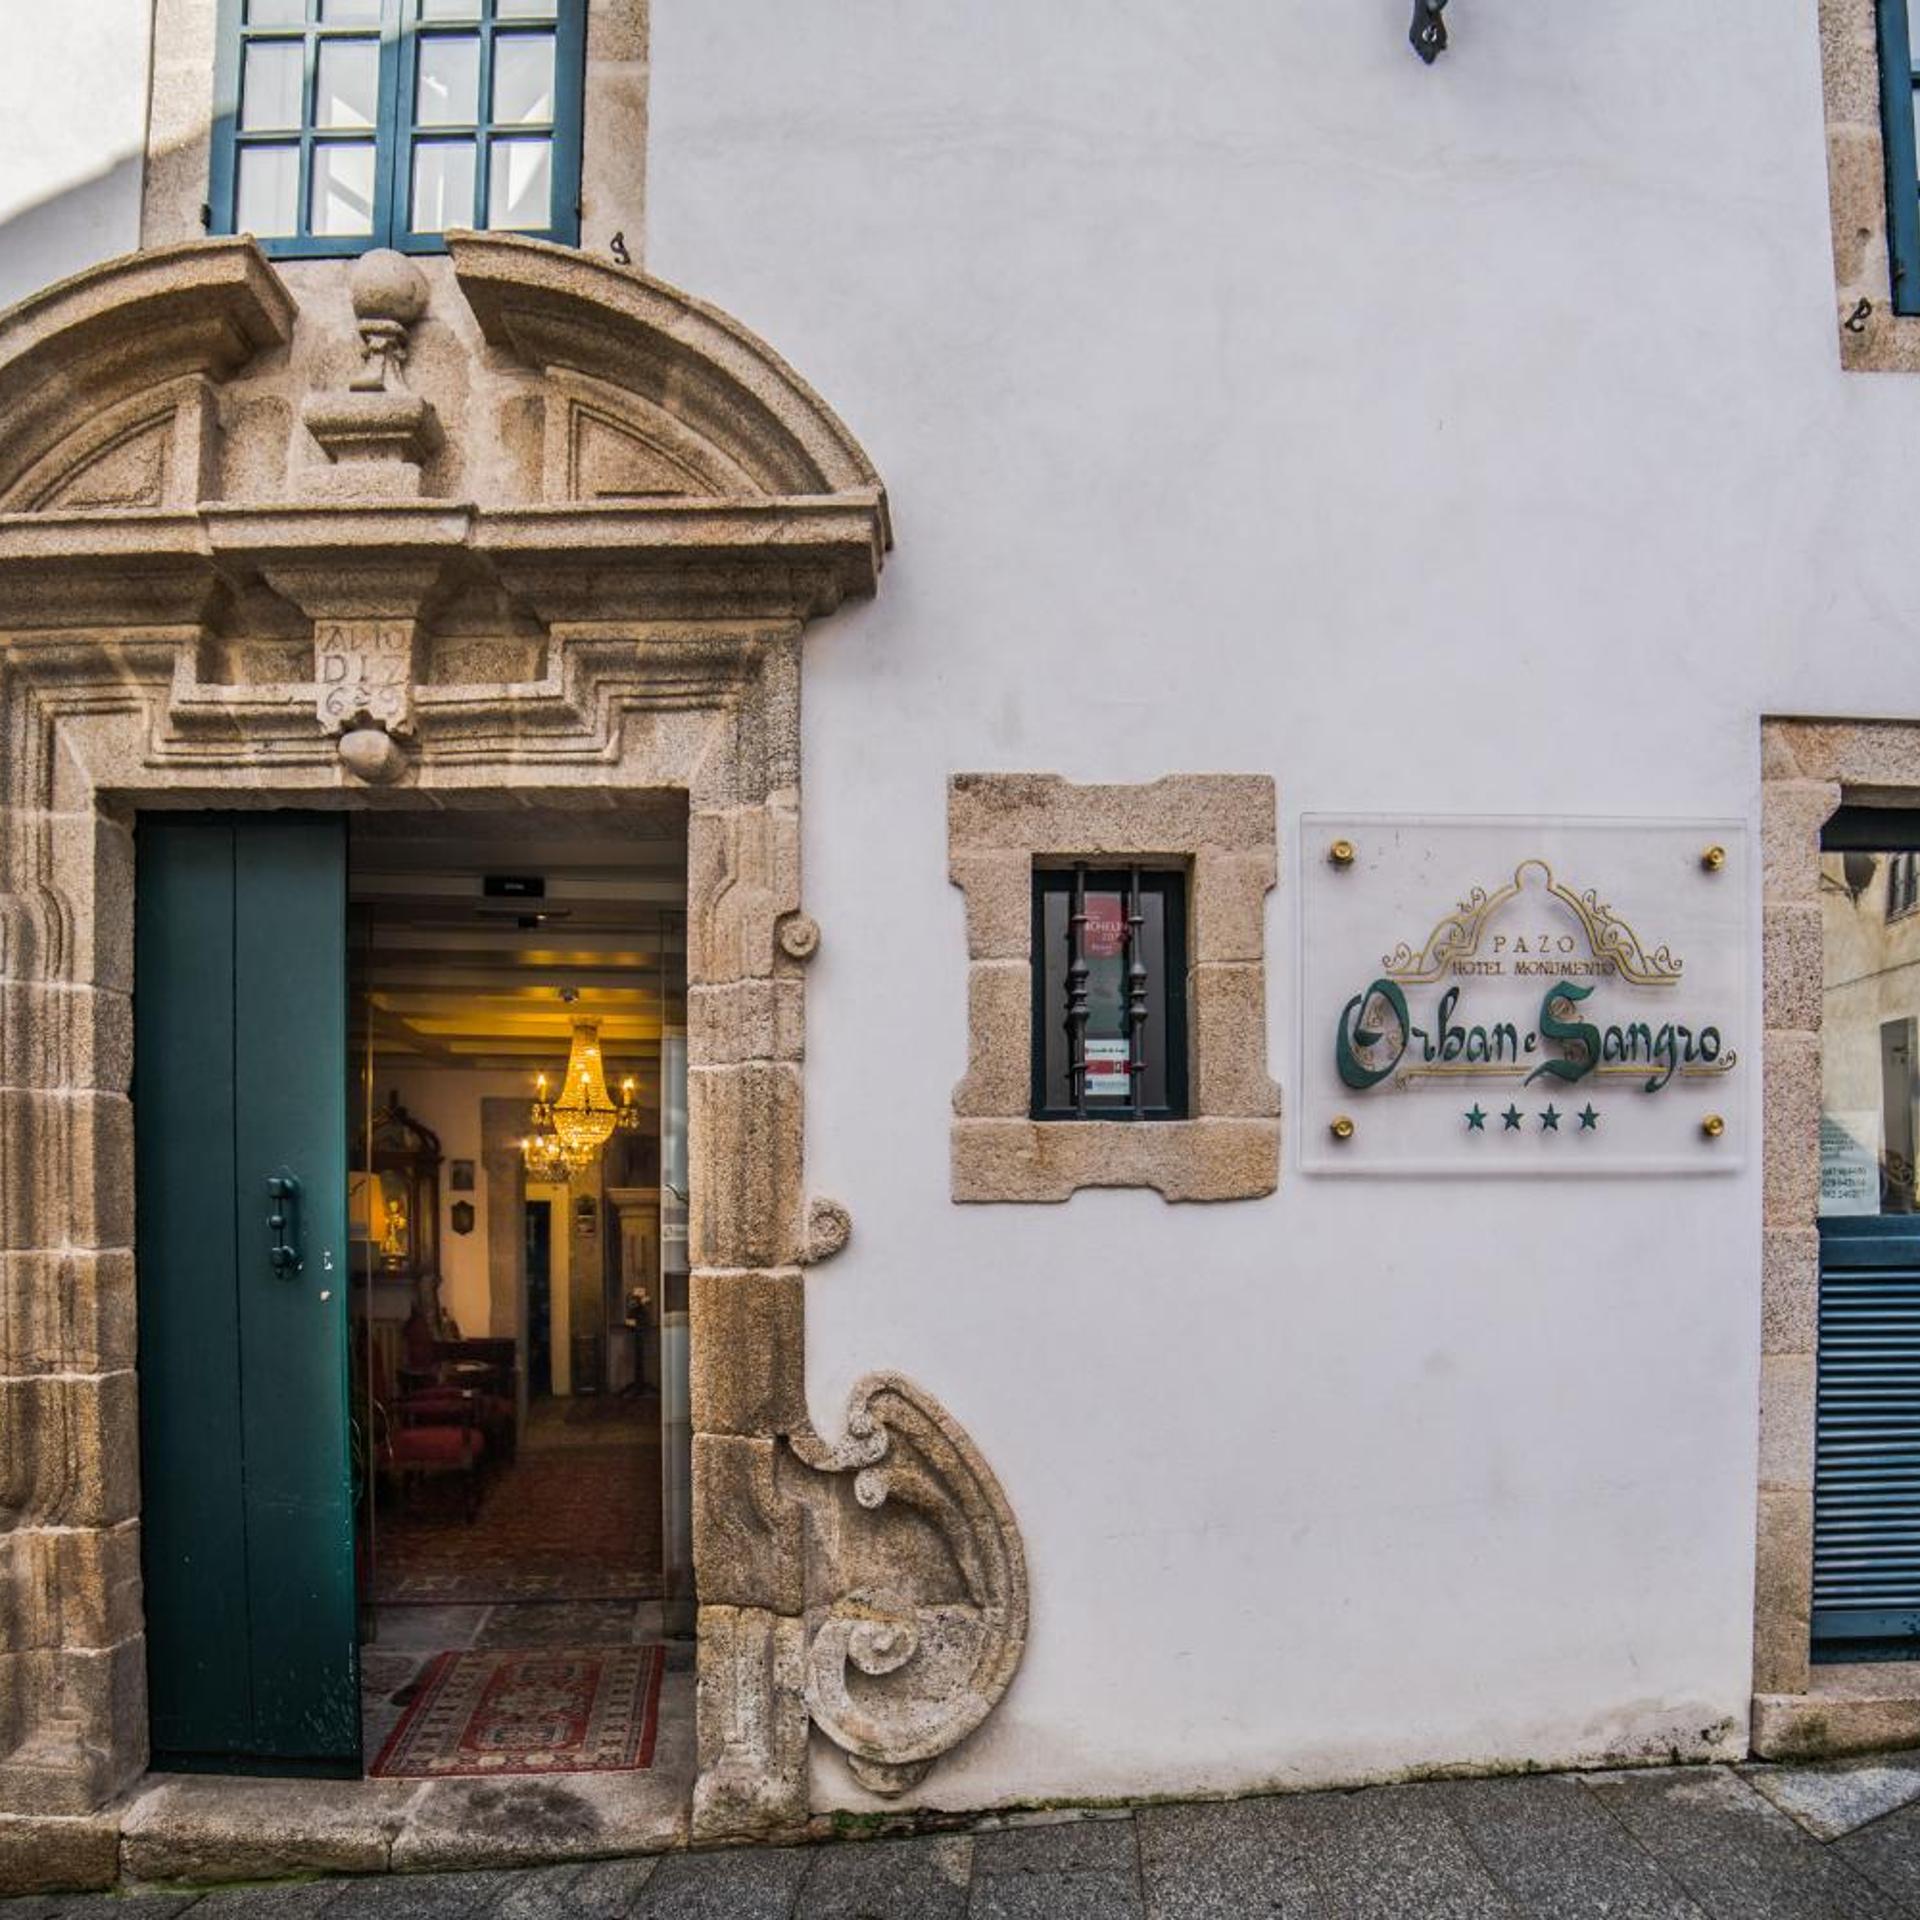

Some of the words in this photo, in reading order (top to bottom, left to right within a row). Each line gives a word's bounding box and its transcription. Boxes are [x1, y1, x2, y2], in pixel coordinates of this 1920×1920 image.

[1493, 935, 1575, 954] PAZO
[1452, 960, 1507, 976] HOTEL
[1514, 960, 1616, 977] MONUMENTO
[1523, 1031, 1537, 1053] e
[1524, 980, 1720, 1093] Sangro
